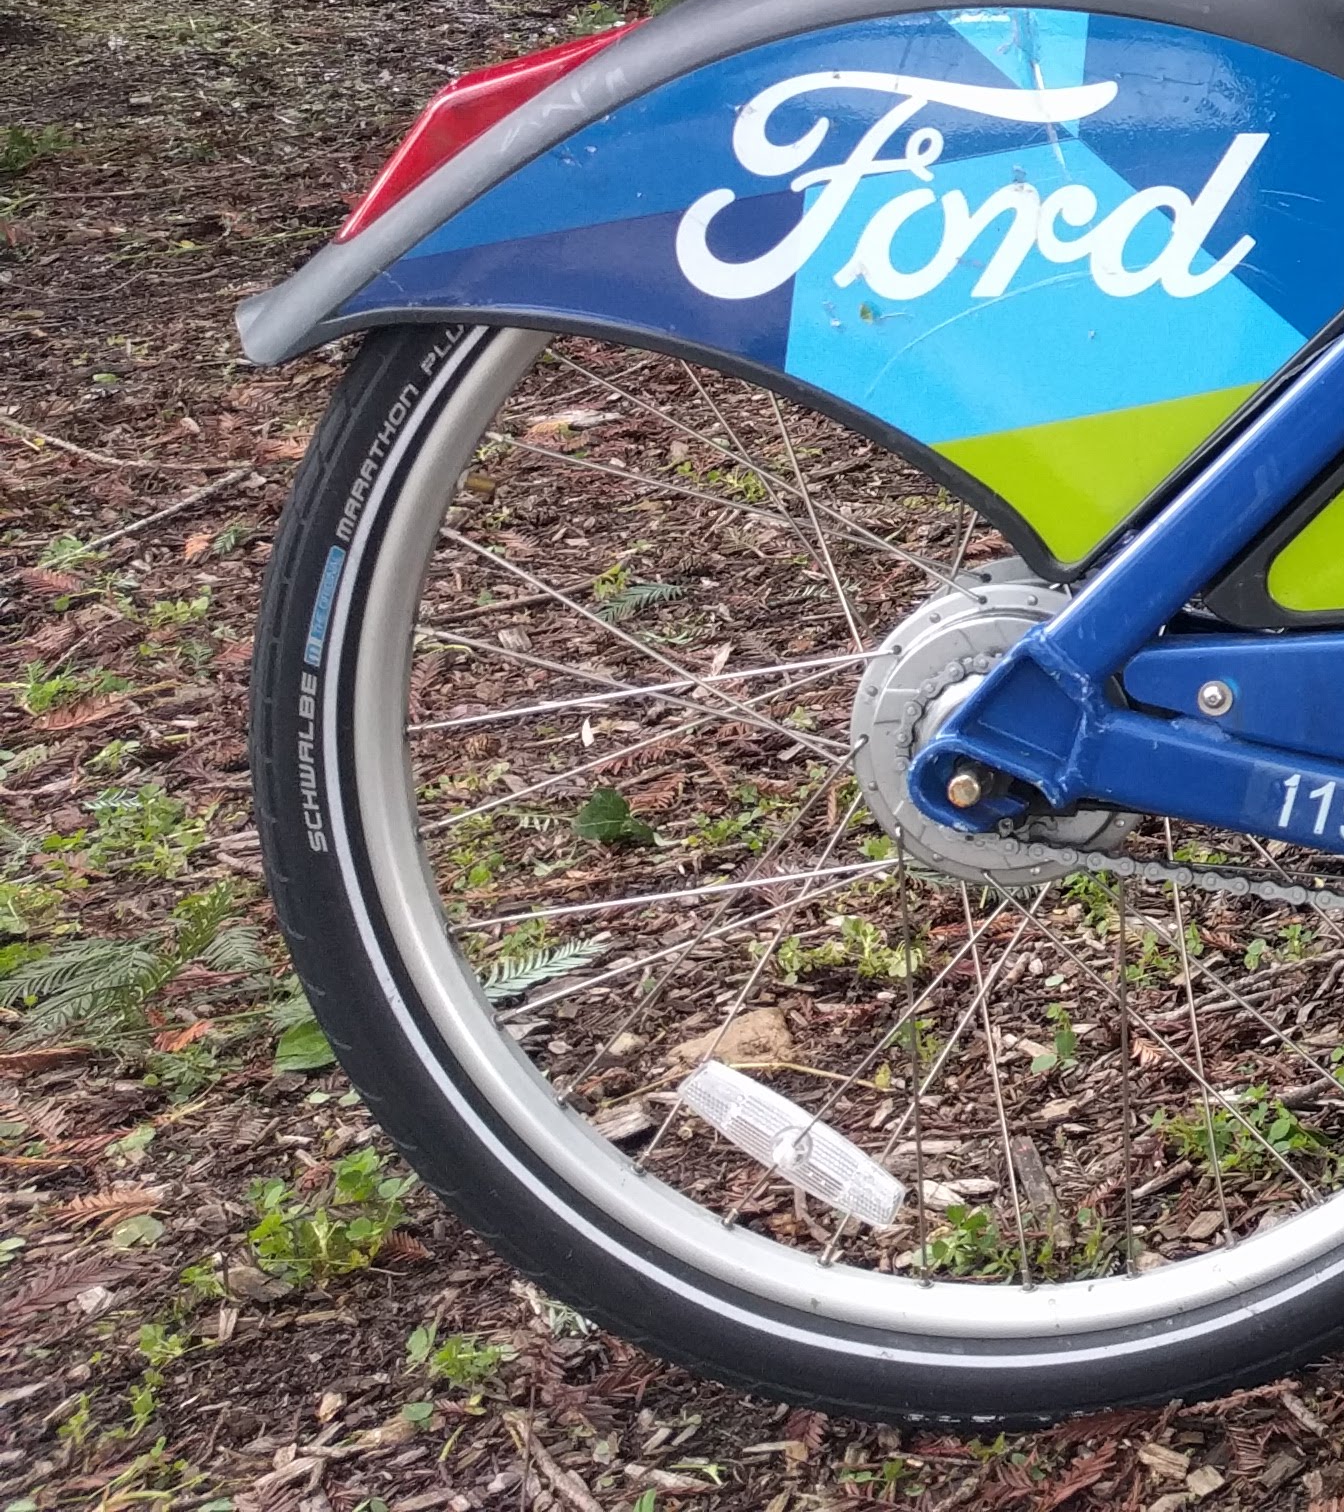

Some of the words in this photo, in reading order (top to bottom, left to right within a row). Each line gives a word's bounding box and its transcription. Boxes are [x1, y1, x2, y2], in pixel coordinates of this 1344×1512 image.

[675, 70, 1270, 300] Ford
[335, 382, 420, 544] MARATHON
[419, 323, 465, 377] PLU
[297, 671, 329, 854] SCHWALBE
